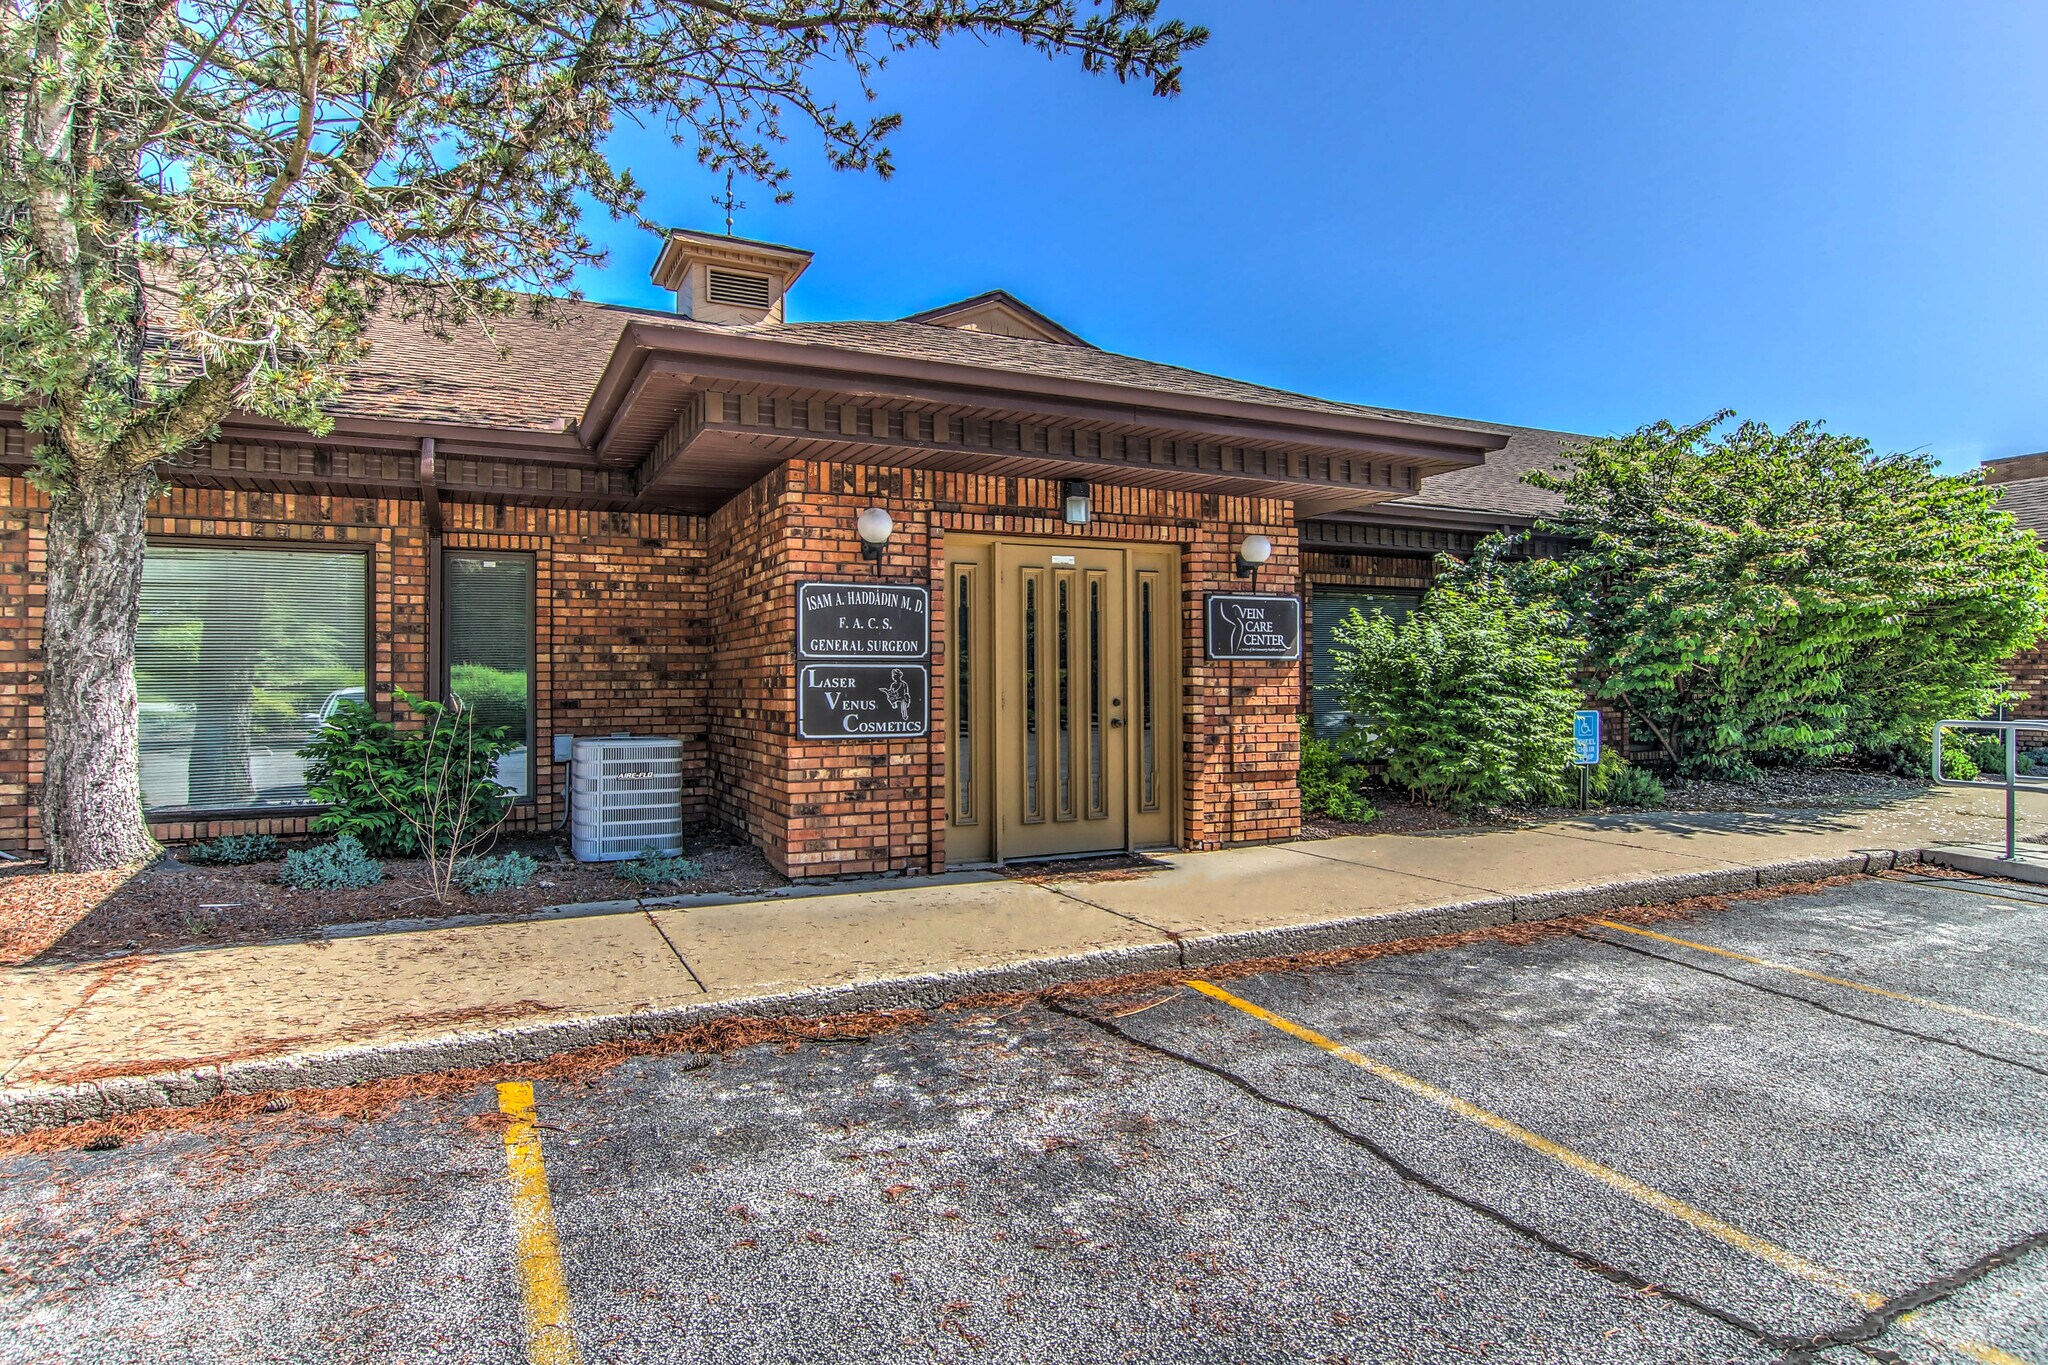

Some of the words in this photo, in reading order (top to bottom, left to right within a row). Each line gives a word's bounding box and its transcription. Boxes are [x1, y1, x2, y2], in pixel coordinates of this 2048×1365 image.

[806, 592, 833, 611] ISAM
[835, 593, 845, 606] A.
[848, 591, 899, 607] HADDADIN
[1239, 608, 1264, 619] VEIN
[839, 617, 849, 629] F.
[852, 617, 864, 629] A.
[868, 617, 878, 629] C.
[882, 618, 892, 630] S.
[1245, 621, 1273, 633] CARE
[810, 639, 865, 652] GENERAL
[867, 639, 918, 652] SURGEON
[1243, 635, 1292, 649] CENTER
[808, 669, 856, 688] LASER
[824, 692, 876, 711] VENUS
[842, 714, 921, 732] COSMETICS
